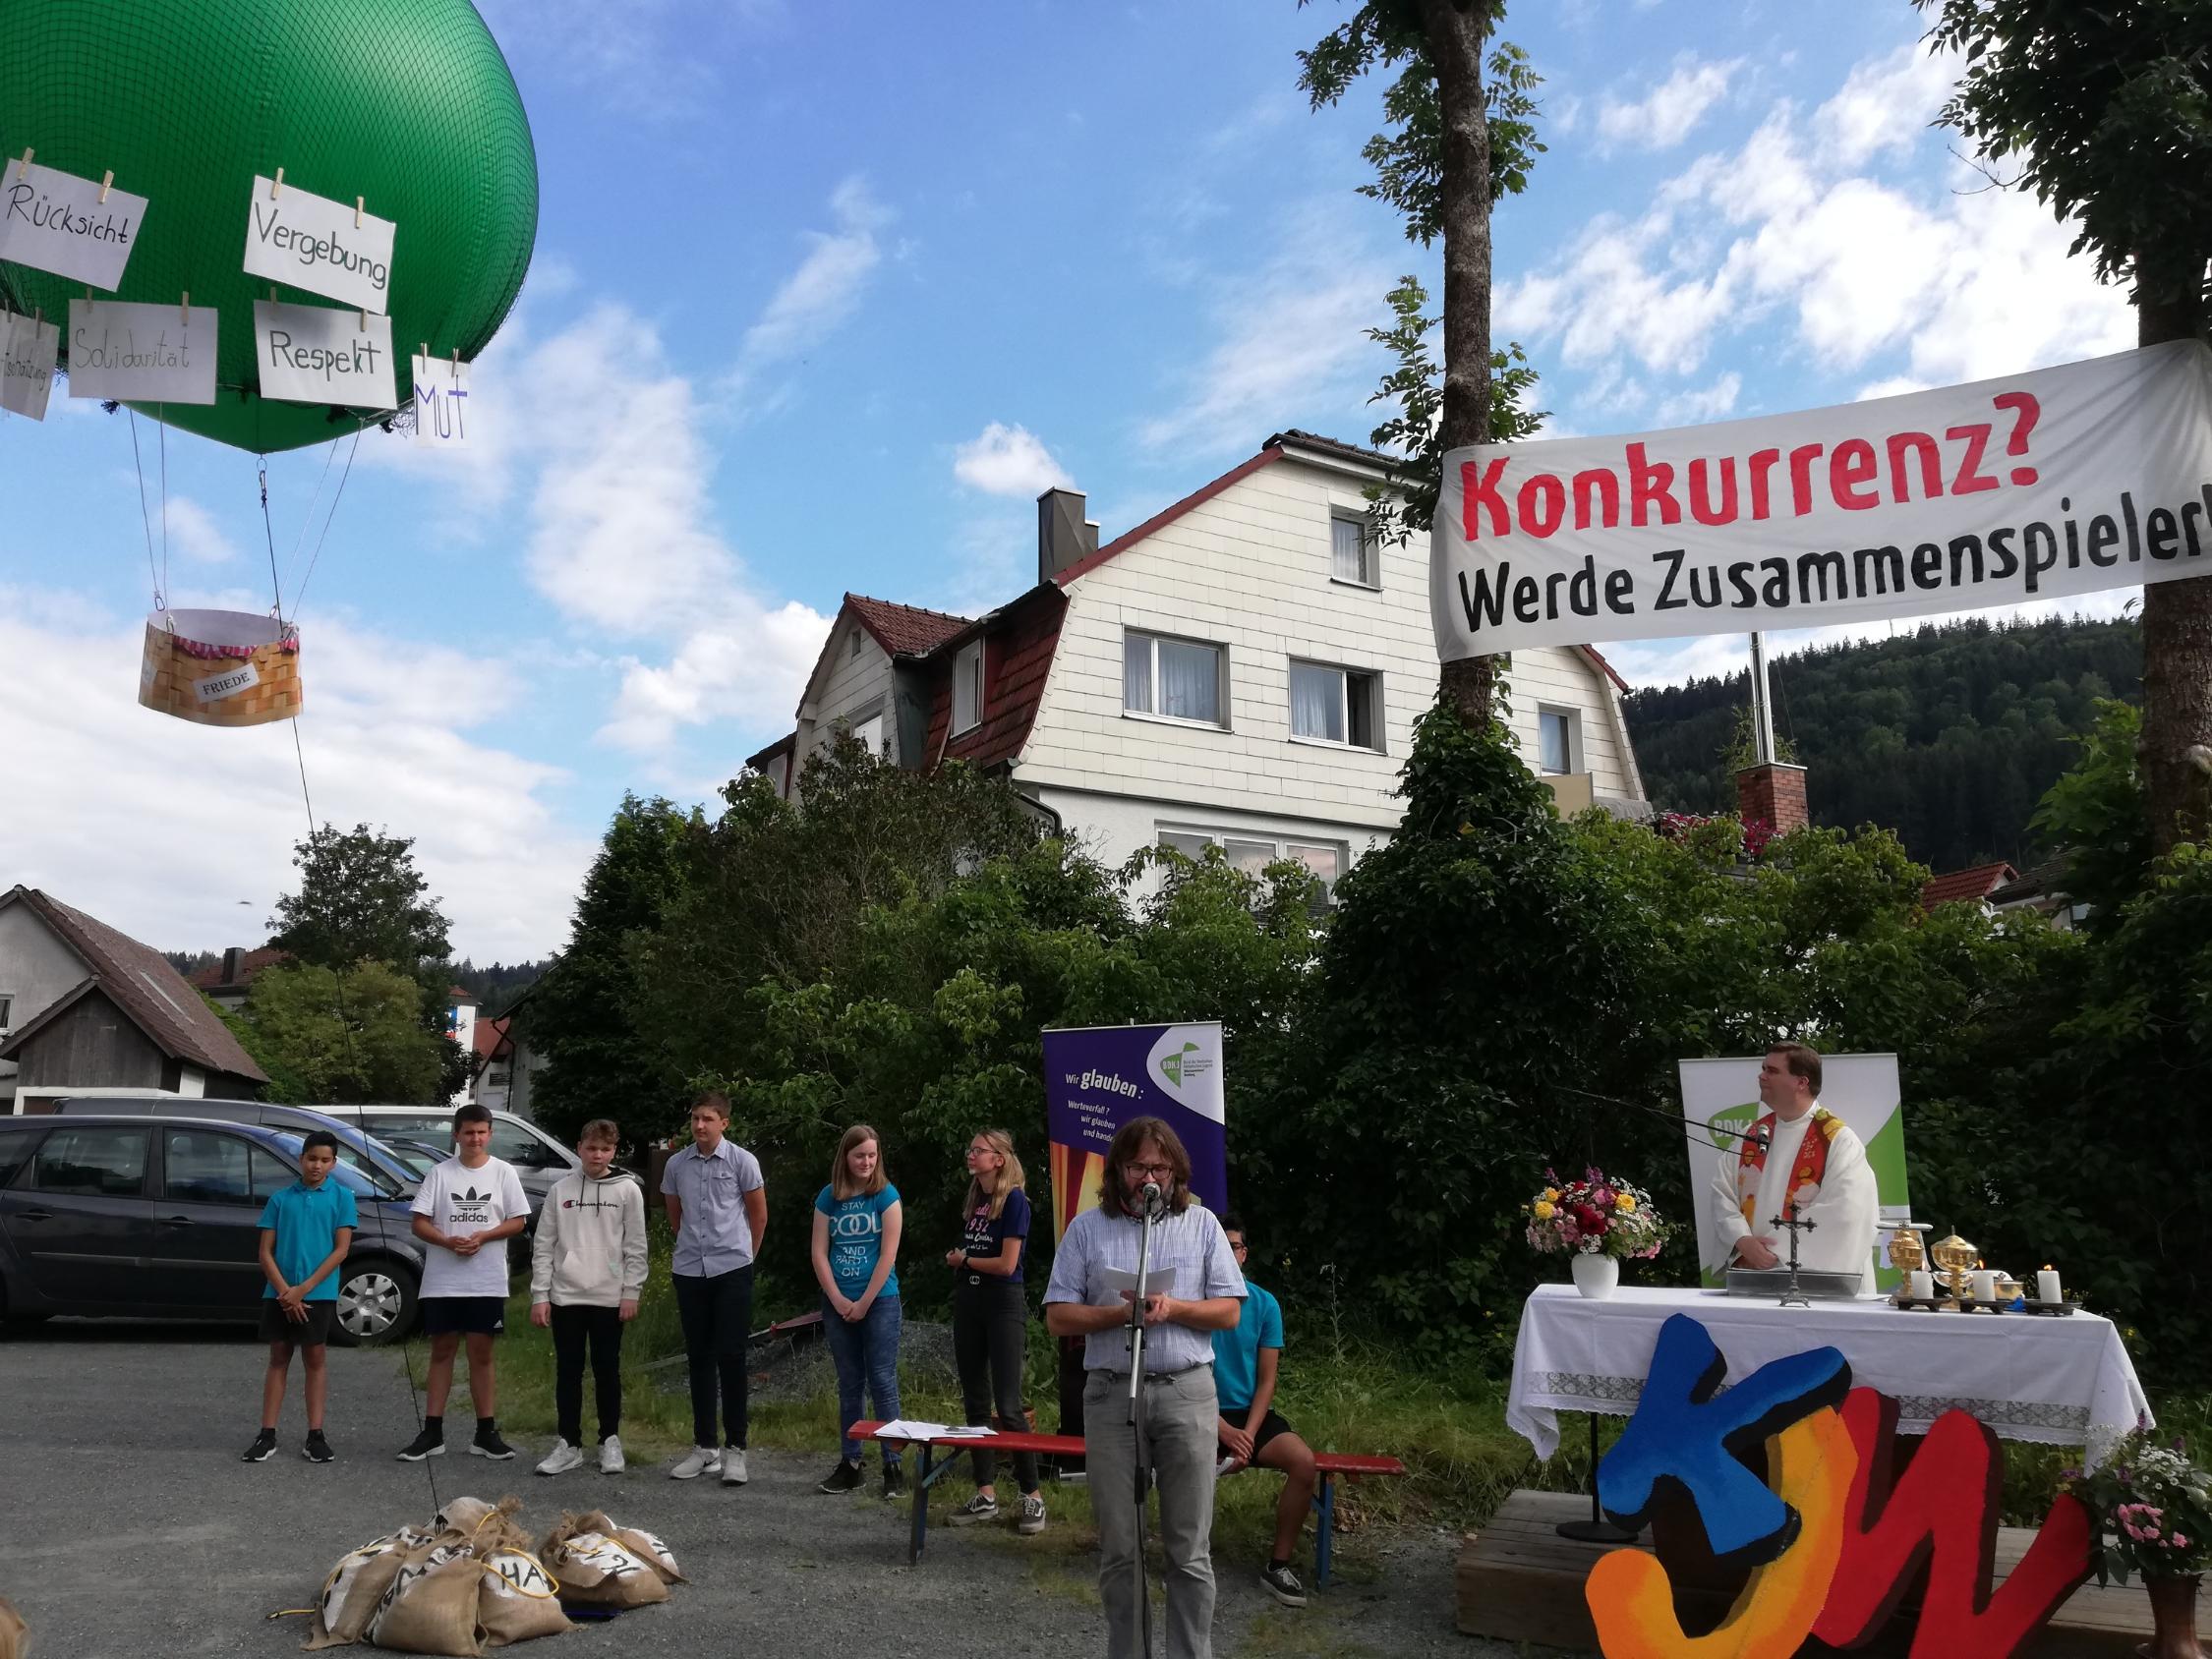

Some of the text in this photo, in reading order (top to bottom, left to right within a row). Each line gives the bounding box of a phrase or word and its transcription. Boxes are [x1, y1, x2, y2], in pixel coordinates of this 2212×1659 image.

[7, 183, 130, 245] Rücksicht
[255, 201, 386, 291] Vergebung
[75, 327, 190, 370] Solidarität
[269, 329, 381, 381] Respekt
[1460, 390, 2042, 543] Konkurrenz?
[1457, 553, 1636, 634] Werde
[202, 671, 251, 696] FRIEDE
[1065, 1073, 1080, 1085] Wir
[1091, 1116, 1116, 1129] glauben
[1082, 1128, 1095, 1138] und
[841, 1201, 866, 1211] STAY
[449, 1213, 489, 1224] adidas
[843, 1245, 866, 1256] AND
[841, 1267, 860, 1277] ON
